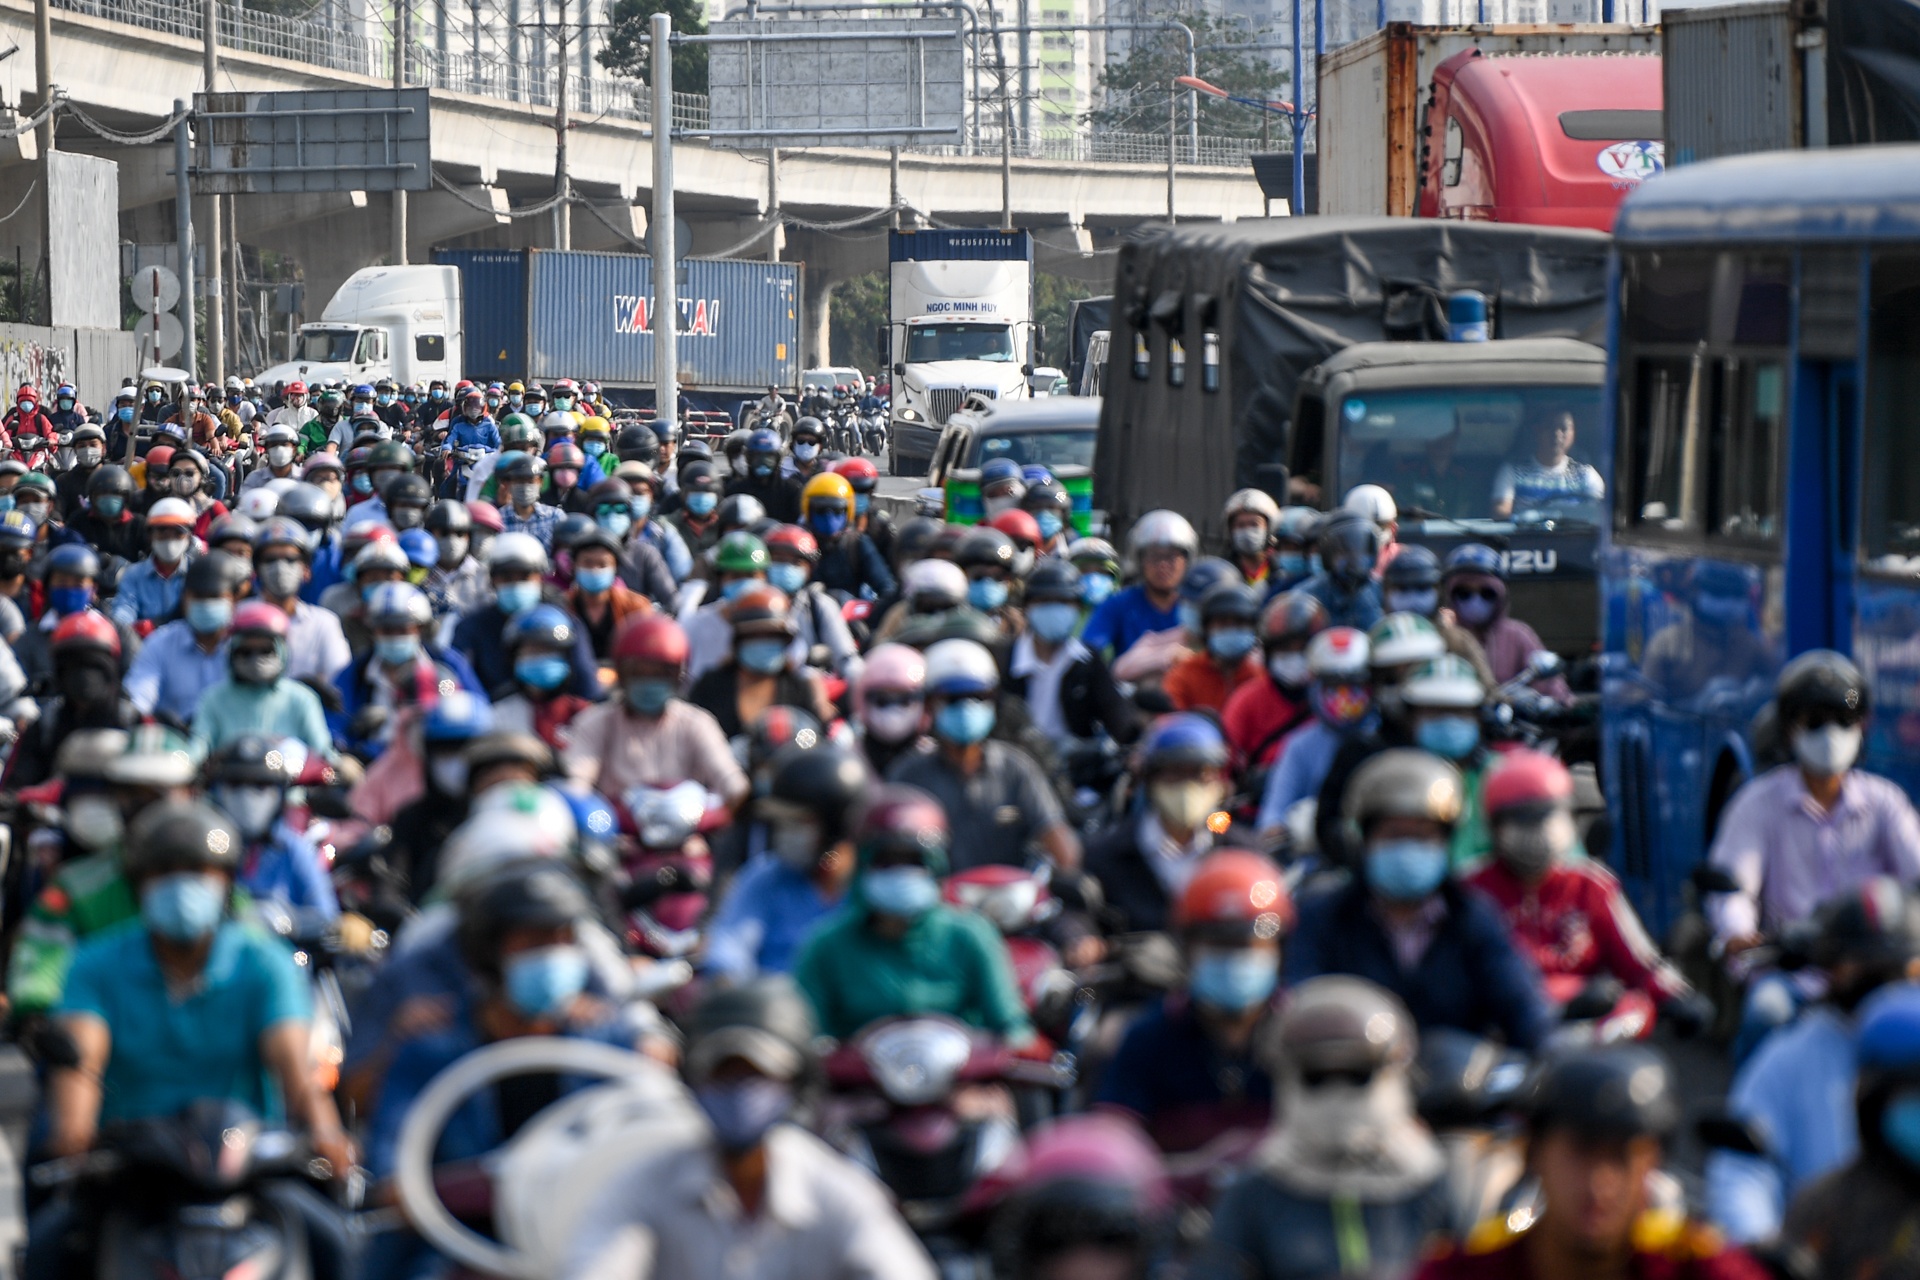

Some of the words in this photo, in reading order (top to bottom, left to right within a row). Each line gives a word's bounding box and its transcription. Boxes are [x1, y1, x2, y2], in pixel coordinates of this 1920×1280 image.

[1609, 152, 1664, 169] VT
[926, 302, 951, 314] NGỌC
[953, 302, 978, 312] MINH
[981, 303, 998, 313] HUY
